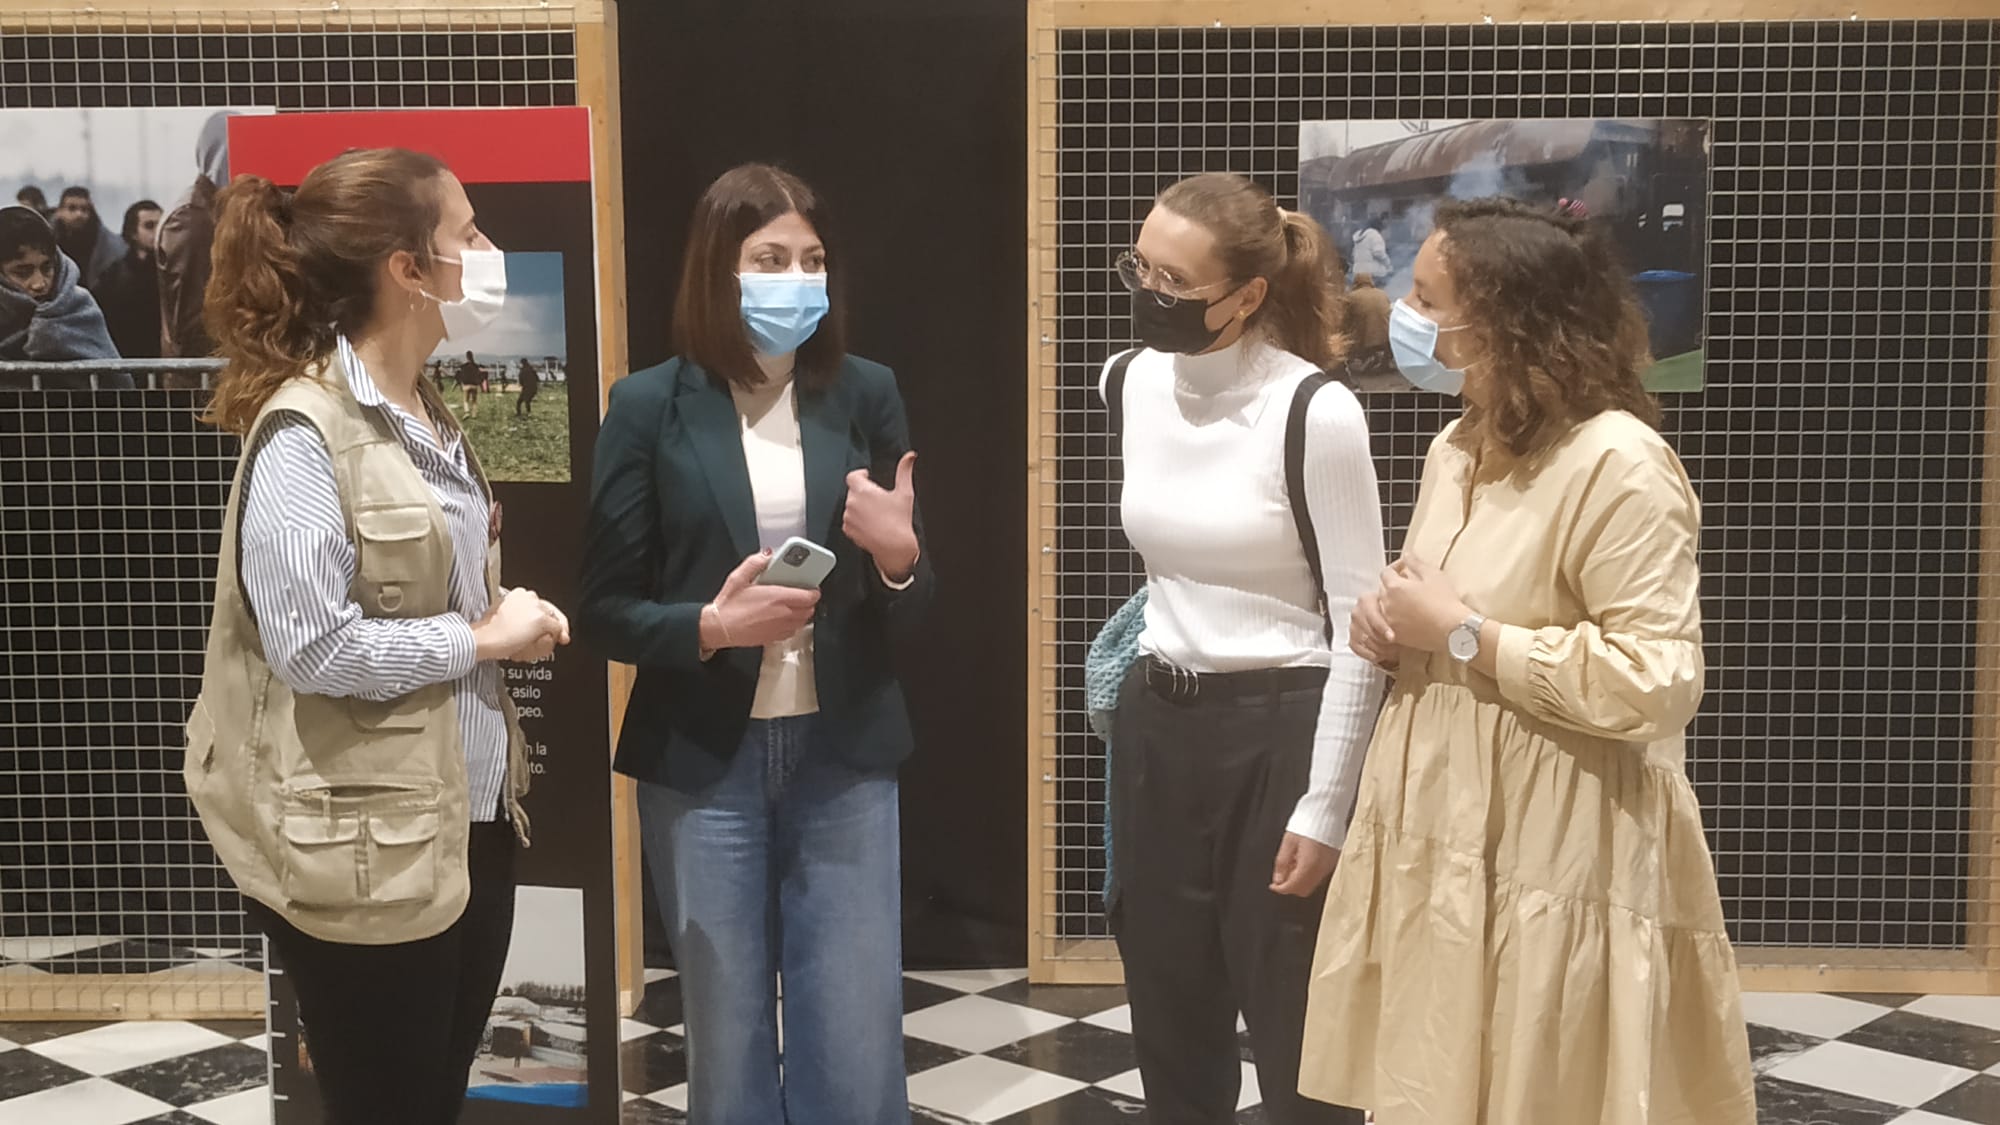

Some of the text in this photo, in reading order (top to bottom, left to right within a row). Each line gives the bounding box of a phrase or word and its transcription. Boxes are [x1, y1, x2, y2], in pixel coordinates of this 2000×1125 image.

[507, 668, 523, 679] su
[525, 666, 553, 680] vida
[512, 685, 541, 699] asilo
[517, 707, 544, 720] peo.
[535, 741, 547, 755] la
[529, 761, 546, 774] to.
